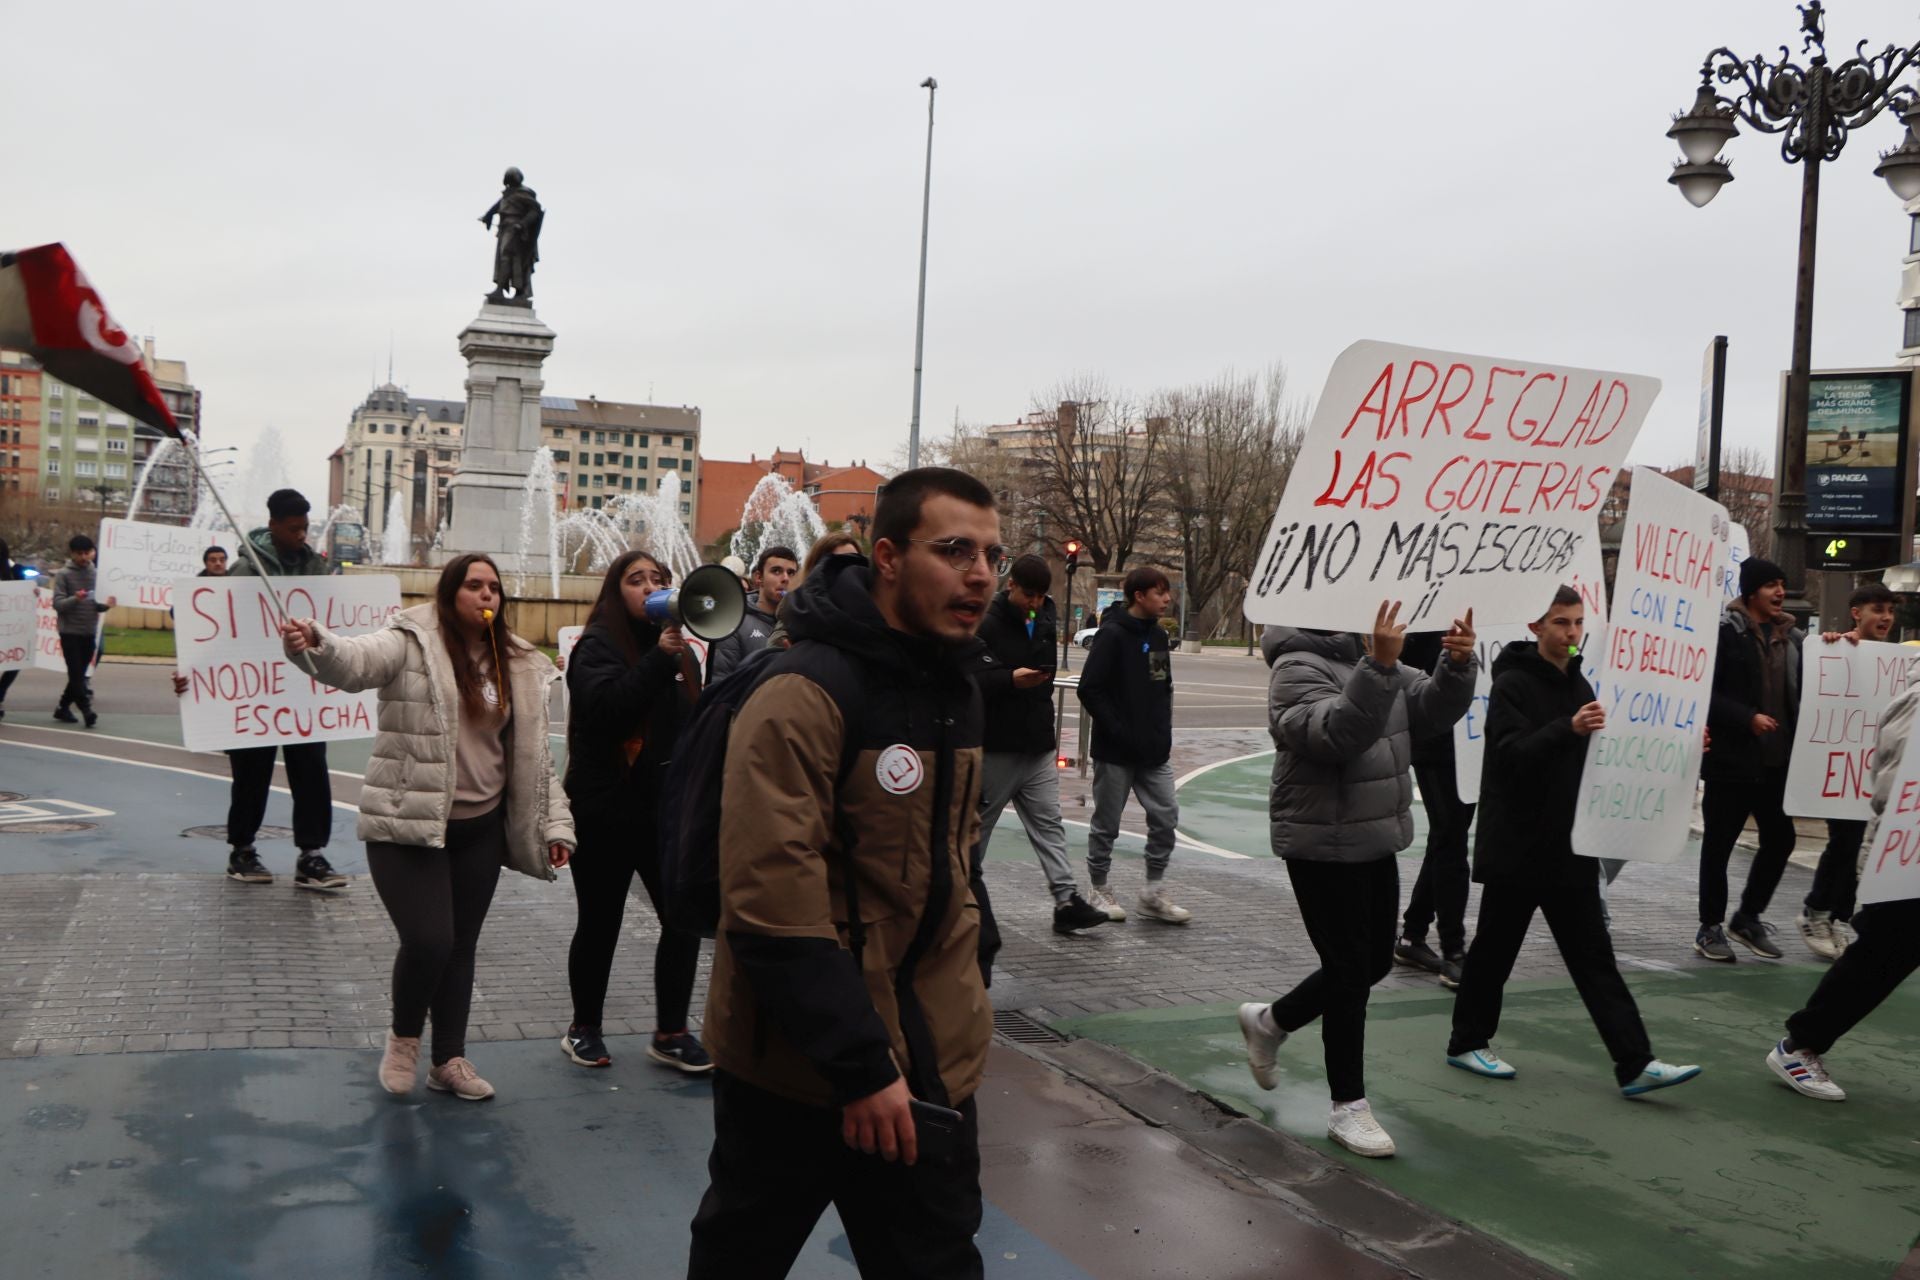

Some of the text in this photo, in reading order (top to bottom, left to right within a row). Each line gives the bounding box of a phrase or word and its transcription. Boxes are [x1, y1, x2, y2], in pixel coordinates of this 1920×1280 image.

[1341, 360, 1629, 448] ARREGLAD
[1837, 399, 1877, 407] GRANDE
[1838, 391, 1872, 399] TIENDA
[1313, 450, 1610, 514] LAS GOTERAS
[1831, 474, 1868, 482] PANGEA
[1369, 512, 1469, 582] MÁS
[1459, 522, 1582, 575] ESCUSAS
[1636, 523, 1714, 598] VILECHA
[192, 588, 237, 642] SI
[1631, 588, 1667, 624] CON
[1674, 598, 1694, 632] EL
[1610, 626, 1707, 682] IES BELLIDO
[1818, 656, 1860, 698] EL
[235, 701, 370, 737] ESCUCHA
[1609, 684, 1696, 734] Y CON LA
